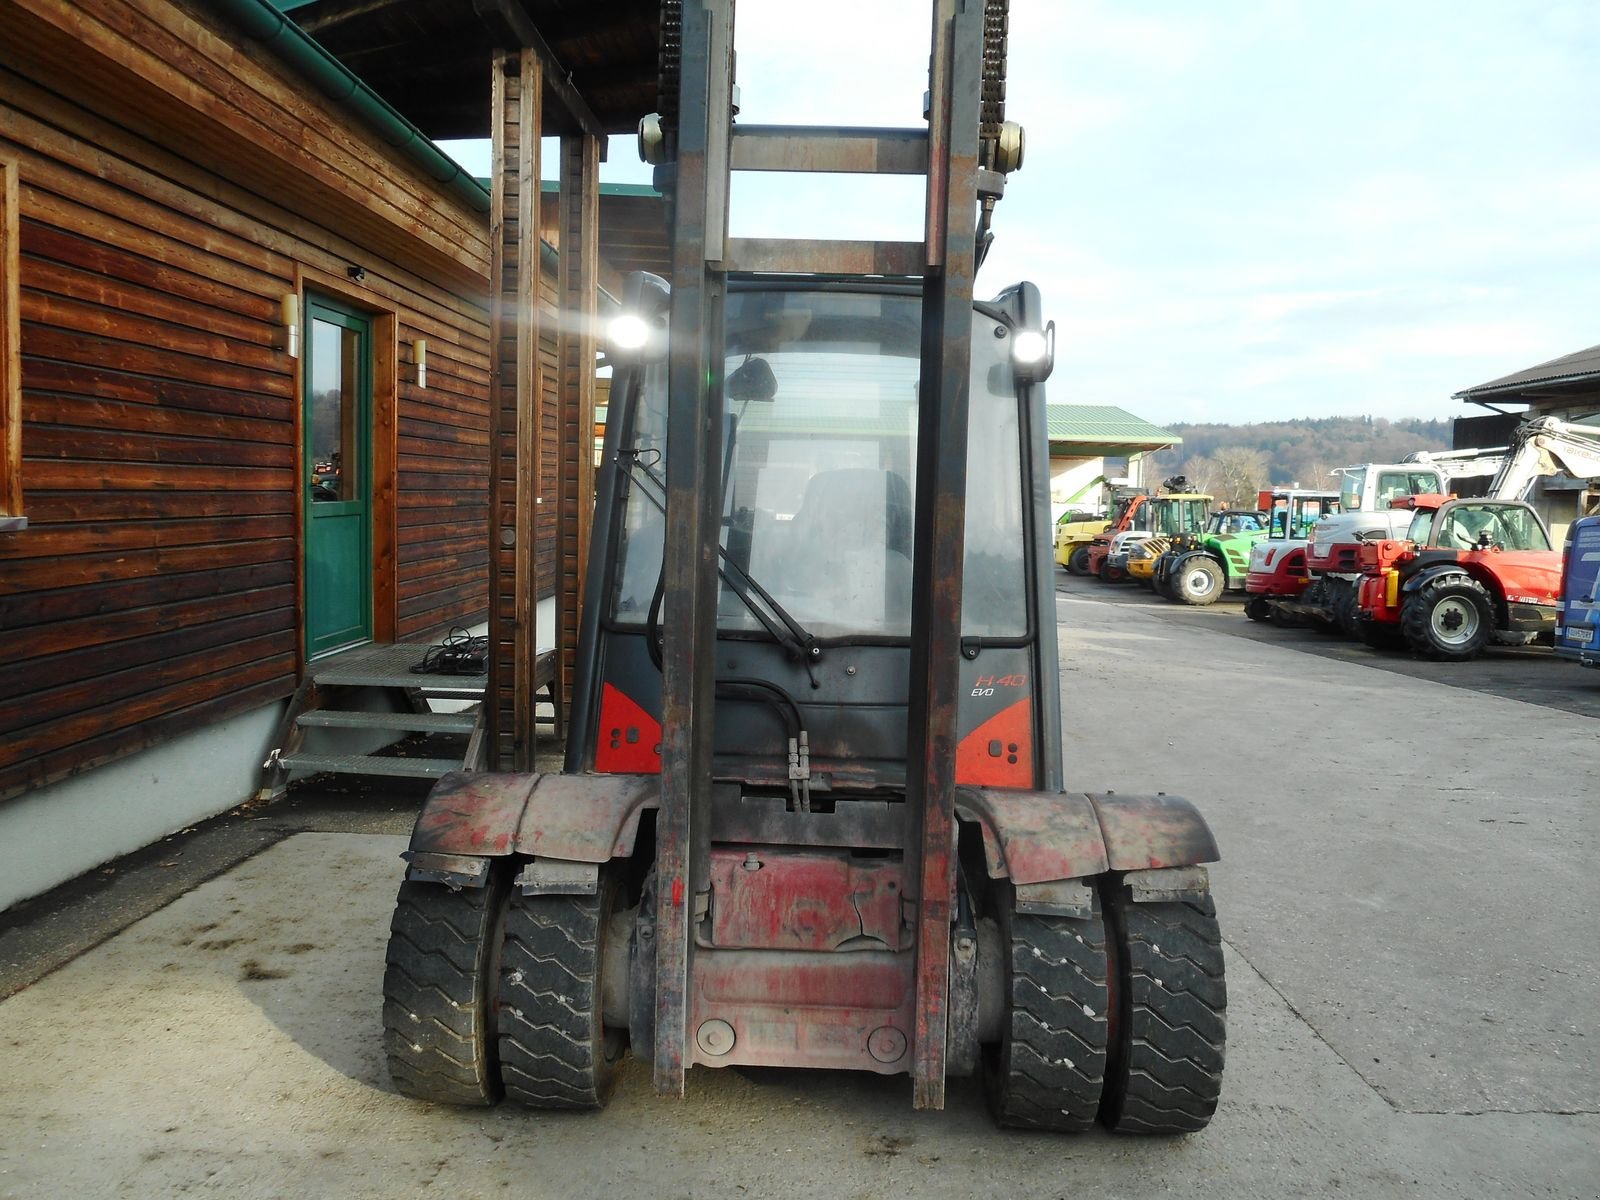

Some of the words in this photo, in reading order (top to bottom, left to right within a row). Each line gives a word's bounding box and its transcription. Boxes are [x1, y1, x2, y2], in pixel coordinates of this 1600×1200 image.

[976, 675, 994, 687] H
[996, 674, 1026, 687] 40
[971, 688, 994, 697] EVO
